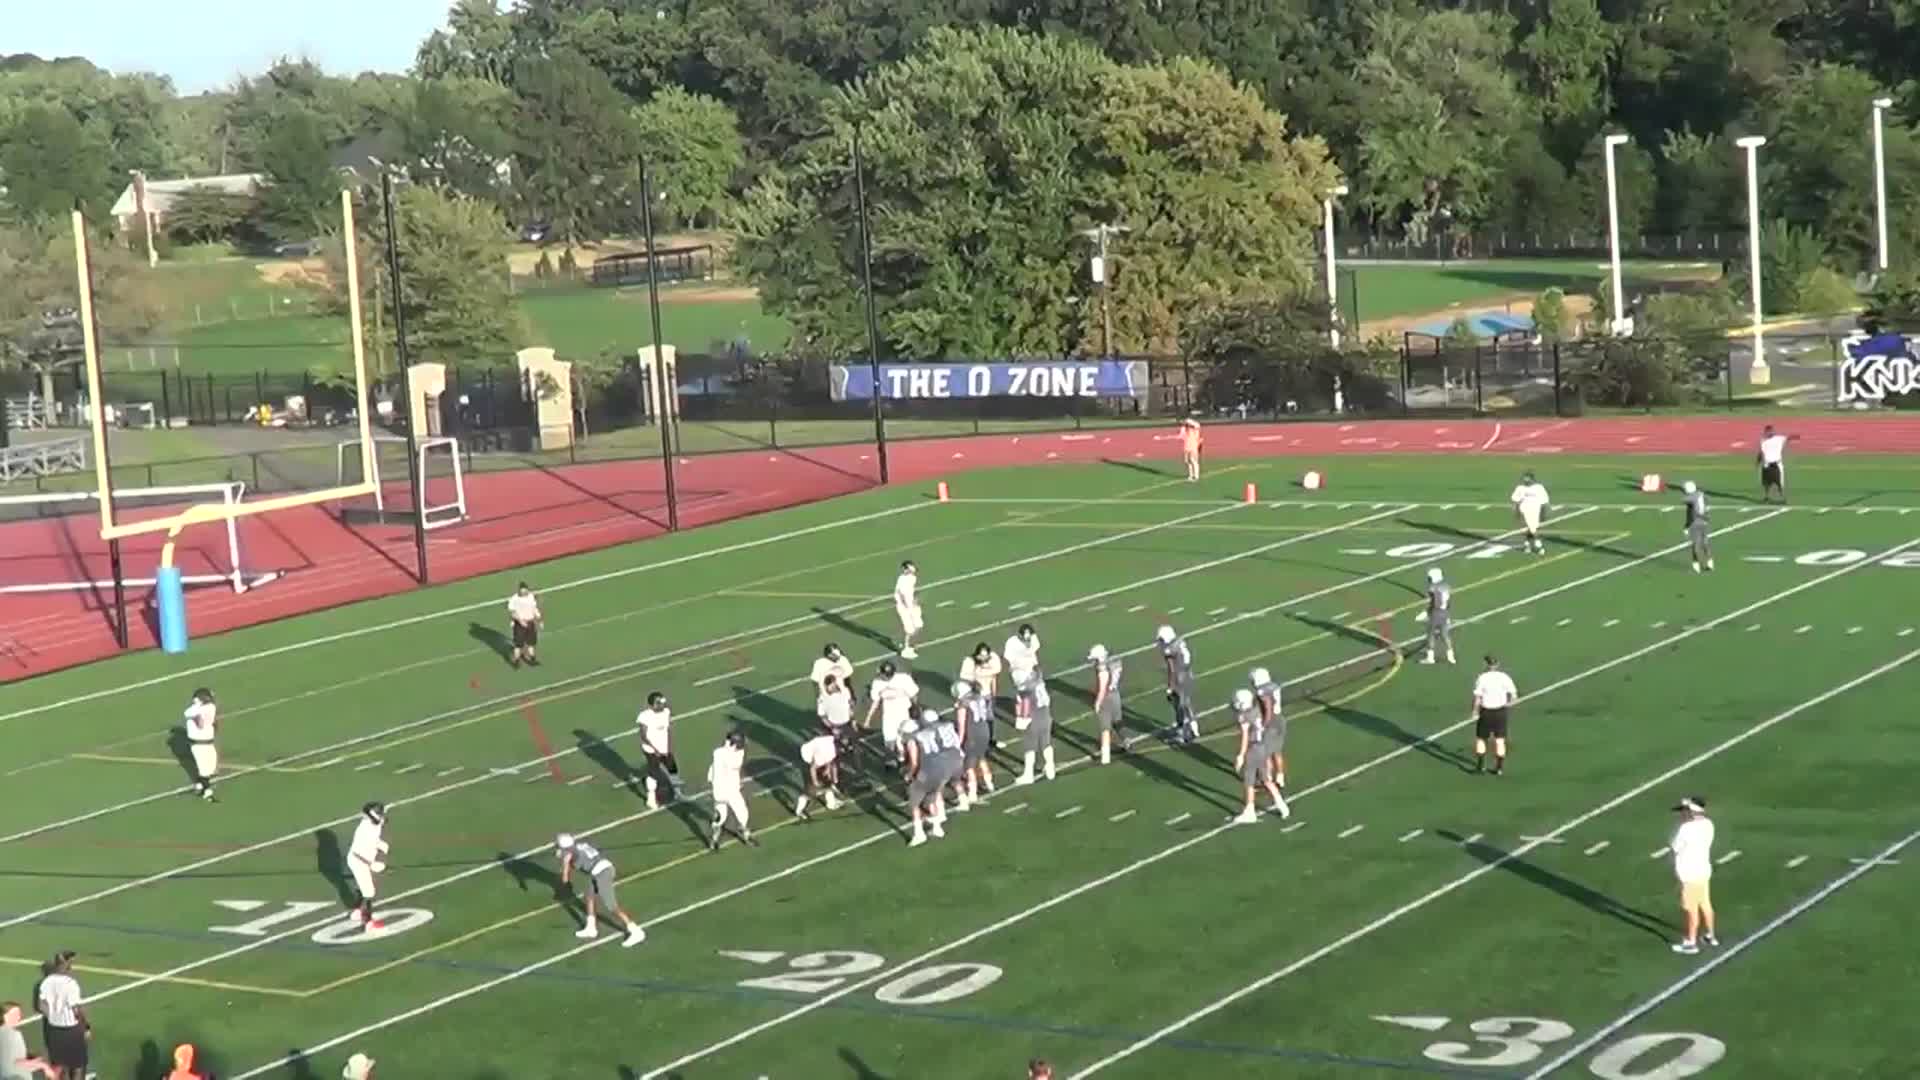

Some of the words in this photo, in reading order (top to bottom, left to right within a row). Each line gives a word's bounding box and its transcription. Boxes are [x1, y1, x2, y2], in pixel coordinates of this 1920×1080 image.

[887, 368, 951, 398] THE
[967, 365, 991, 396] O
[1007, 366, 1099, 397] ZONE
[1838, 355, 1920, 401] KNI
[208, 900, 435, 944] 10
[735, 950, 1003, 1004] 20
[1422, 1016, 1727, 1080] 30
